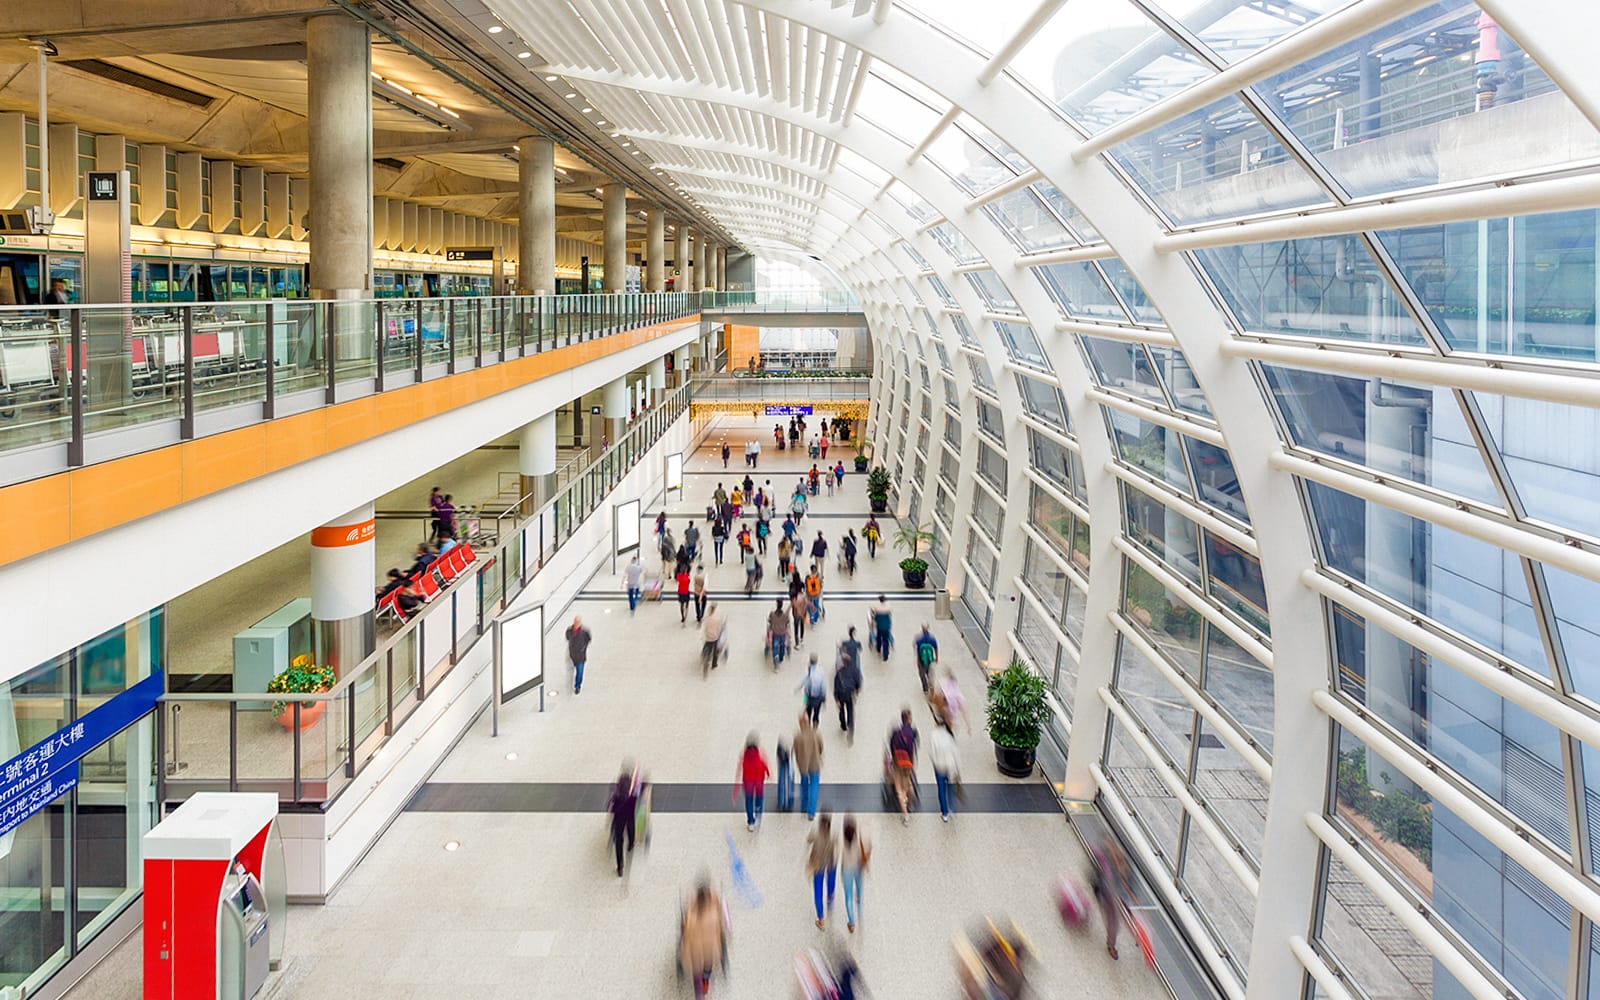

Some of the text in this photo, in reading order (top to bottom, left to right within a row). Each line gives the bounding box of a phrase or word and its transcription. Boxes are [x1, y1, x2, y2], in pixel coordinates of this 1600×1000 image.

[41, 763, 49, 776] 2
[21, 811, 29, 819] to
[29, 787, 58, 814] Mainland
[58, 778, 76, 794] China
